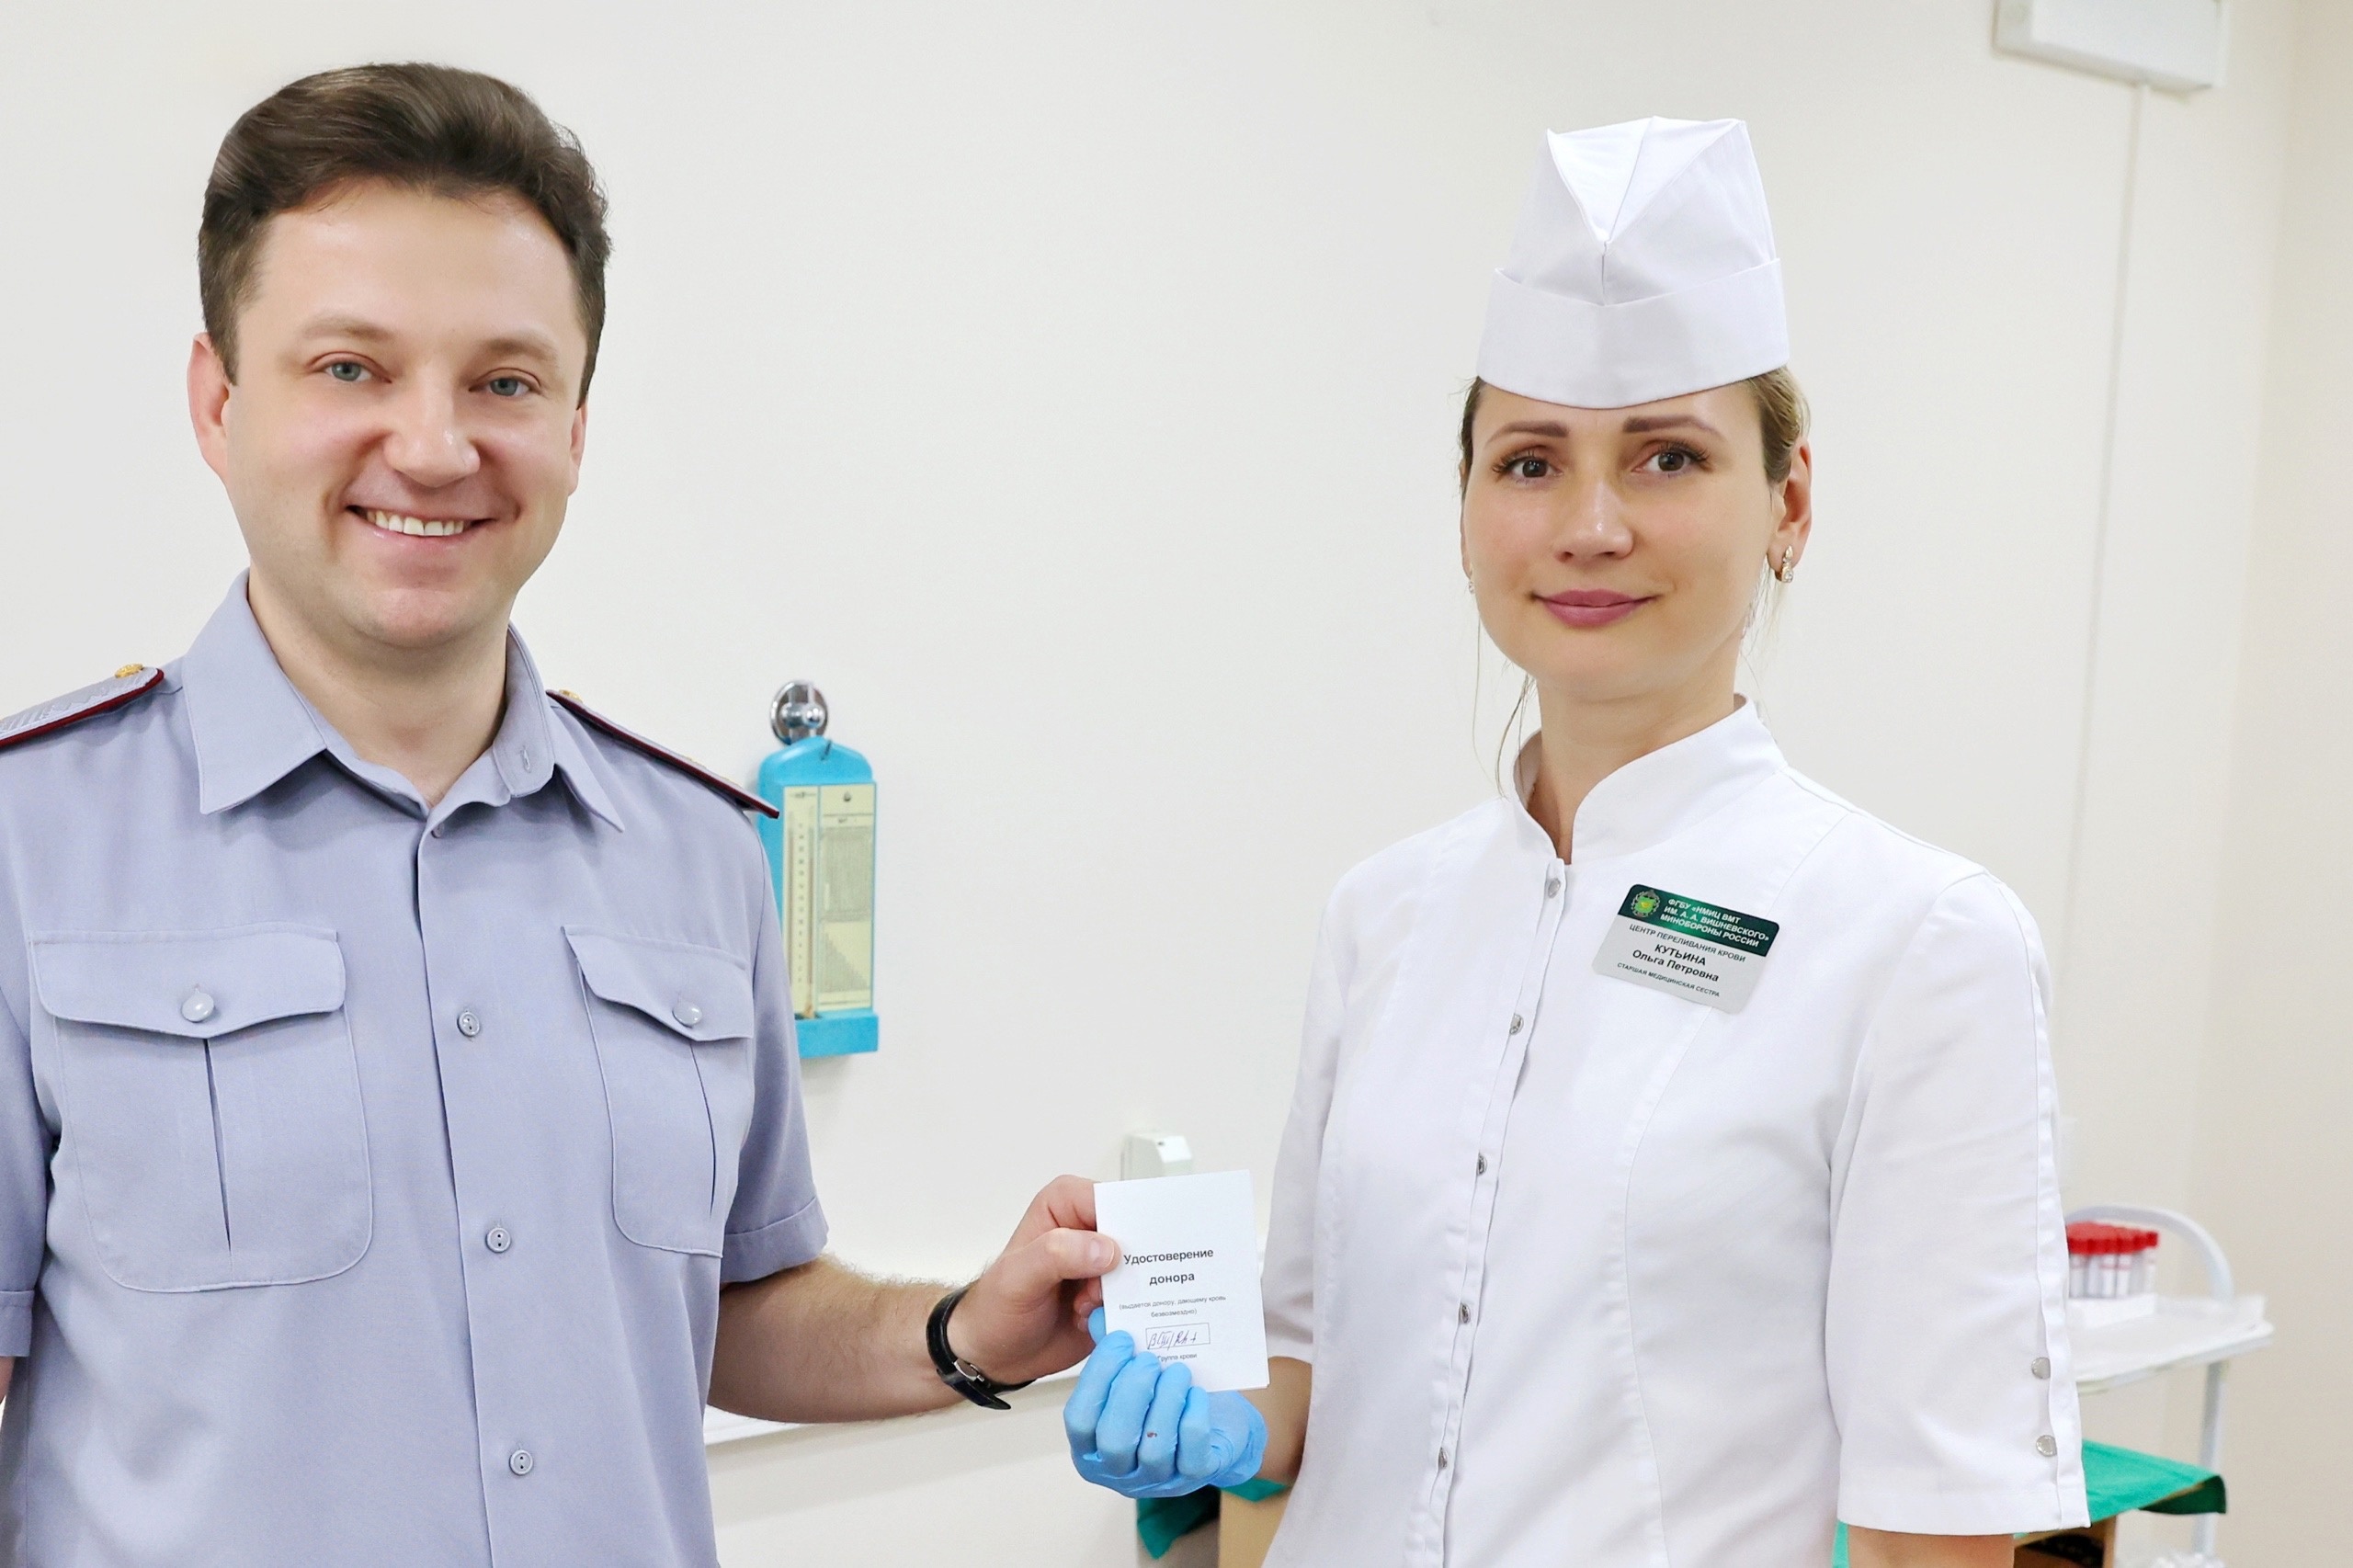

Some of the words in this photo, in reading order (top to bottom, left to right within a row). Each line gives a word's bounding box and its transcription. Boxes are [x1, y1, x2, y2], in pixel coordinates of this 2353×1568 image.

[1664, 905, 1680, 915] ИМ.
[1680, 910, 1688, 919] А.
[1690, 913, 1699, 922] А.
[1700, 915, 1769, 941] ВИШНЕВСКОГО»
[1667, 898, 1691, 910] ФГБУ
[1691, 904, 1722, 920] «НМИЦ
[1722, 913, 1741, 924] ВМТ
[1629, 924, 1656, 936] ЦЕНТР
[1656, 932, 1717, 953] ПЕРЕЛИВАНИЯ
[1718, 949, 1746, 962] КРОВИ
[1660, 914, 1722, 937] МИНОБОРОНЫ
[1722, 931, 1759, 948] РОССИИ
[1632, 949, 1665, 966] Ольга
[1666, 960, 1720, 983] Петровна
[1654, 944, 1706, 966] КУТЬИНА
[1617, 962, 1648, 975] СТАРШАЯ
[1648, 971, 1695, 990] МЕДИЦИНСКАЯ
[1695, 986, 1720, 997] СЕСТРА
[1123, 1249, 1214, 1265] Удостоверение
[1149, 1273, 1195, 1286] донора
[1120, 1301, 1151, 1310] (выдается
[1177, 1297, 1207, 1306] дающему
[1209, 1295, 1226, 1303] кровь
[1151, 1308, 1198, 1318] безвозмездно)
